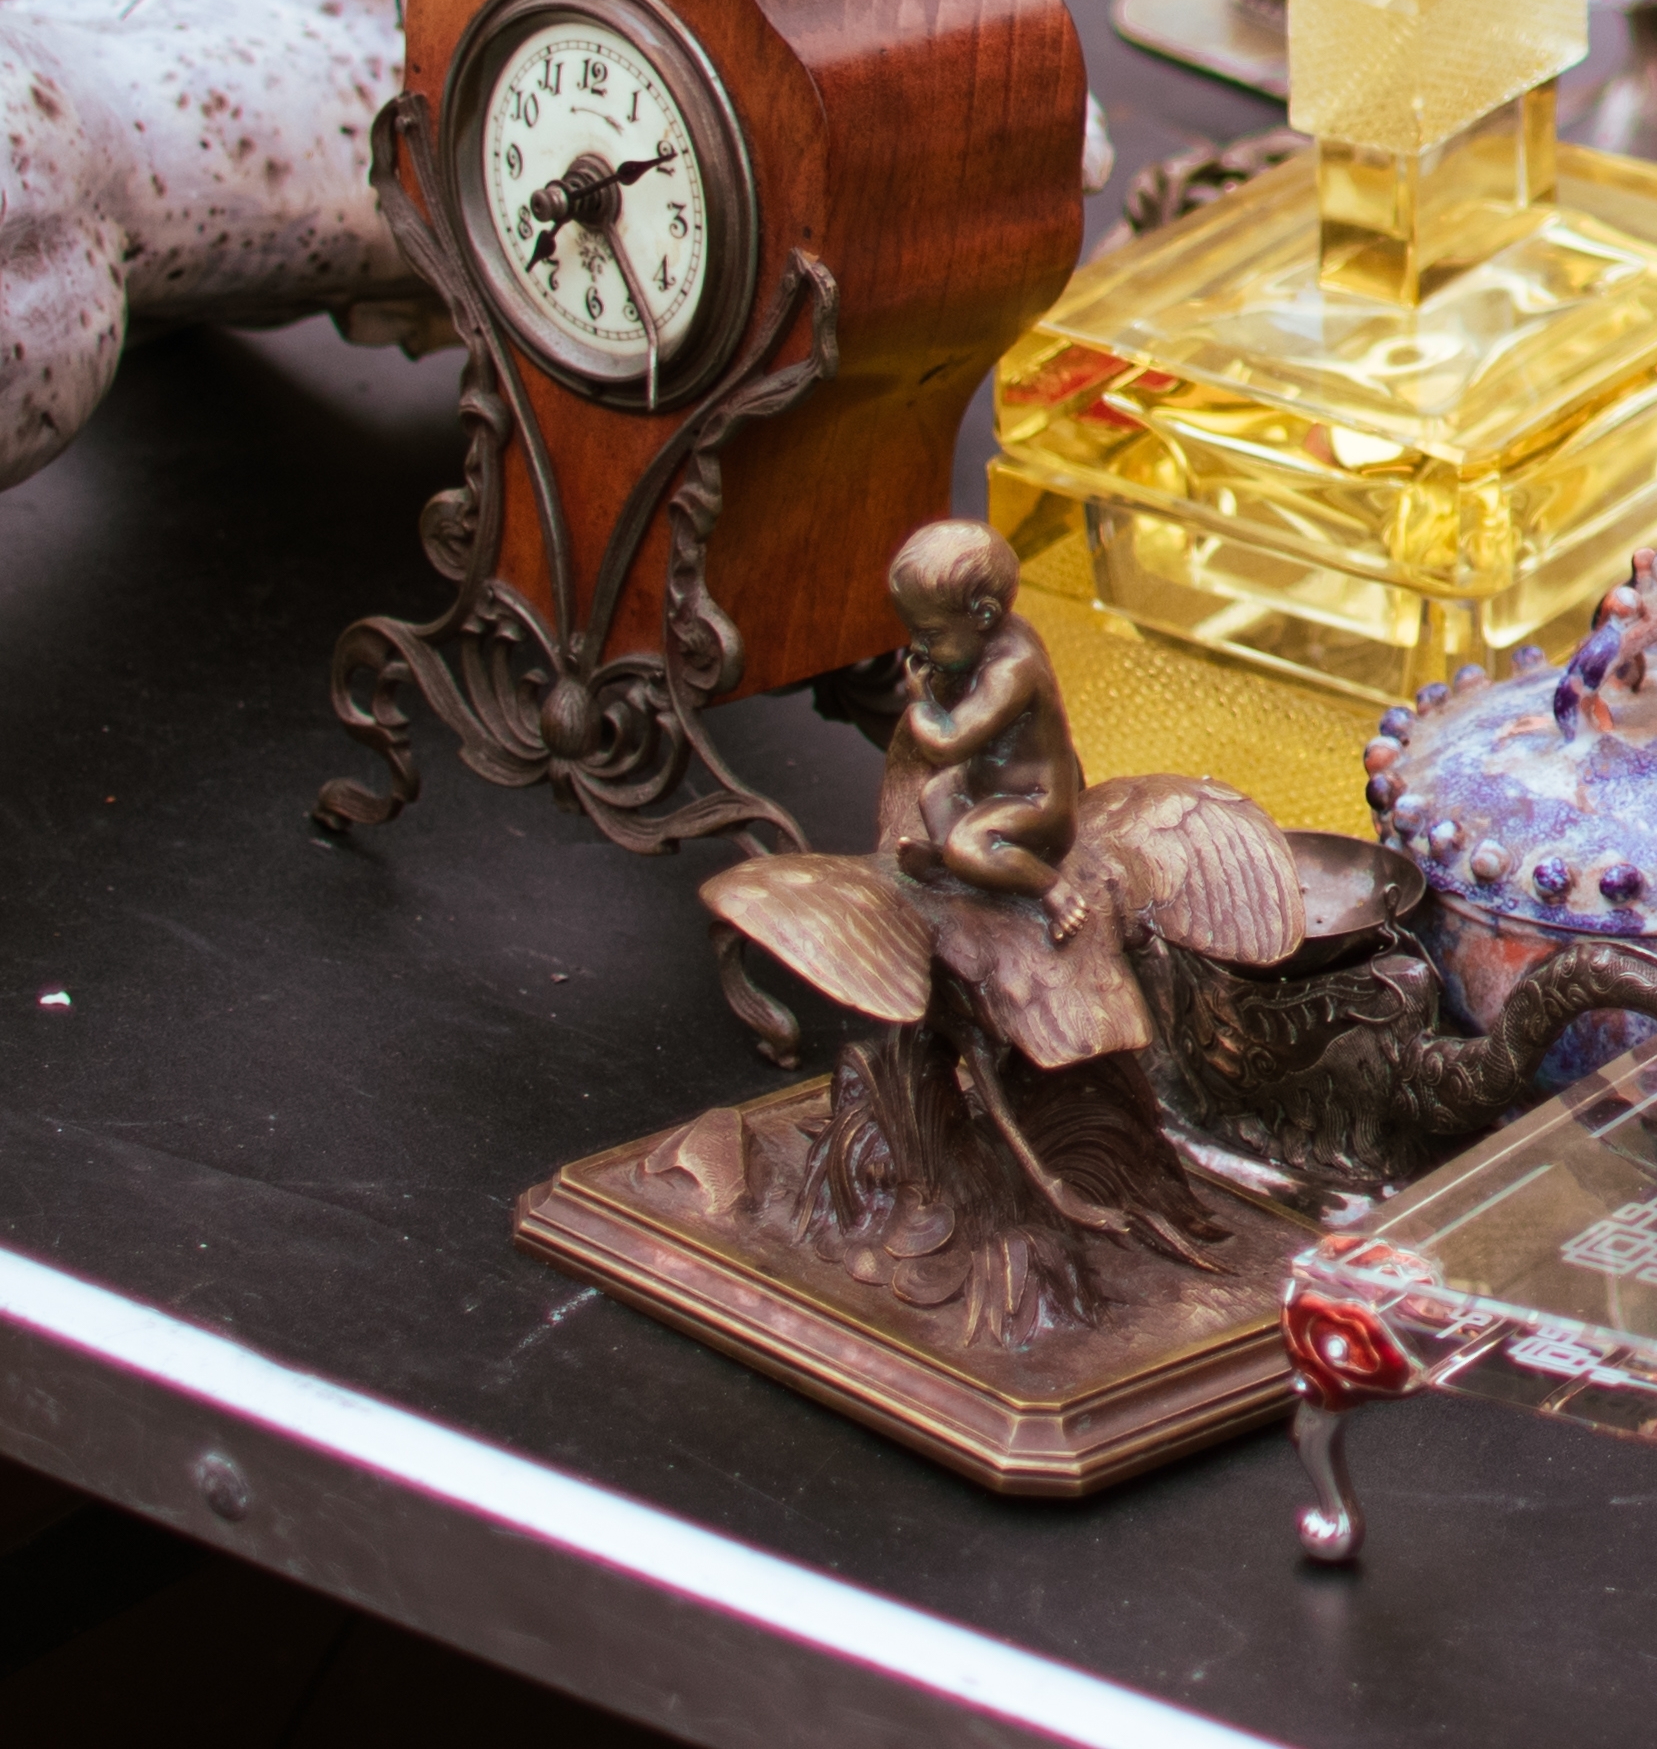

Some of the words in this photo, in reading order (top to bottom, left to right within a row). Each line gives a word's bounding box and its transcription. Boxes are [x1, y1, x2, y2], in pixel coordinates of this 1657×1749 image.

[538, 57, 564, 95] 11
[577, 58, 607, 98] 12
[511, 90, 539, 128] 10
[627, 90, 640, 123] 1
[507, 143, 523, 179] 9
[656, 140, 675, 177] 2
[518, 204, 533, 240] 8
[667, 202, 688, 239] 3
[541, 255, 560, 291] 7
[653, 254, 676, 292] 4
[586, 286, 603, 321] 6
